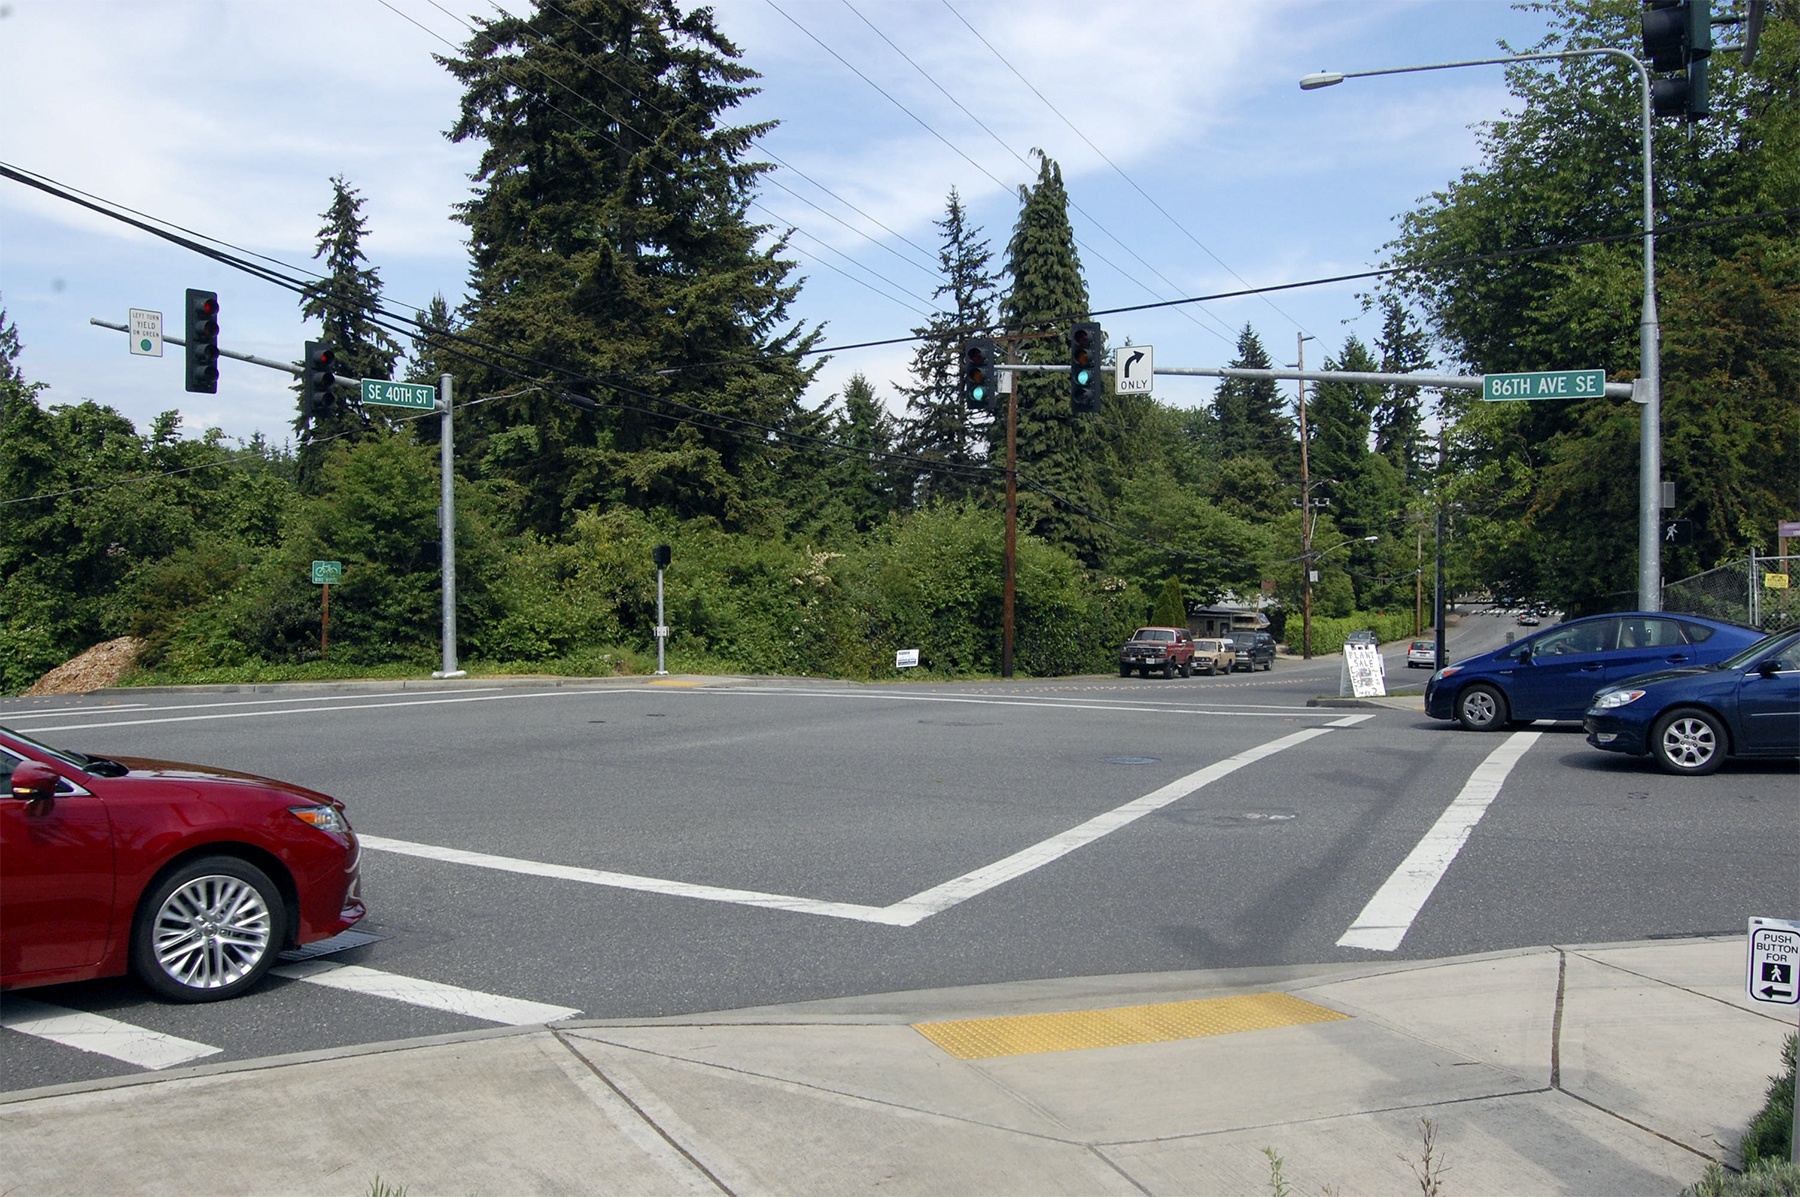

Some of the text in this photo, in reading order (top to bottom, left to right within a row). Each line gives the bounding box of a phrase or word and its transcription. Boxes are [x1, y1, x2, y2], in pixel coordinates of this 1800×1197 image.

[137, 321, 156, 330] YIELD
[1121, 380, 1148, 390] ONLY
[1492, 375, 1596, 396] 86TH AVE SE
[368, 384, 428, 404] SE 40TH ST
[1348, 652, 1374, 660] PLANT
[1354, 660, 1374, 668] SALE
[1764, 934, 1792, 943] PUSH
[1756, 942, 1798, 954] BUTTON
[1766, 953, 1788, 962] FOR
